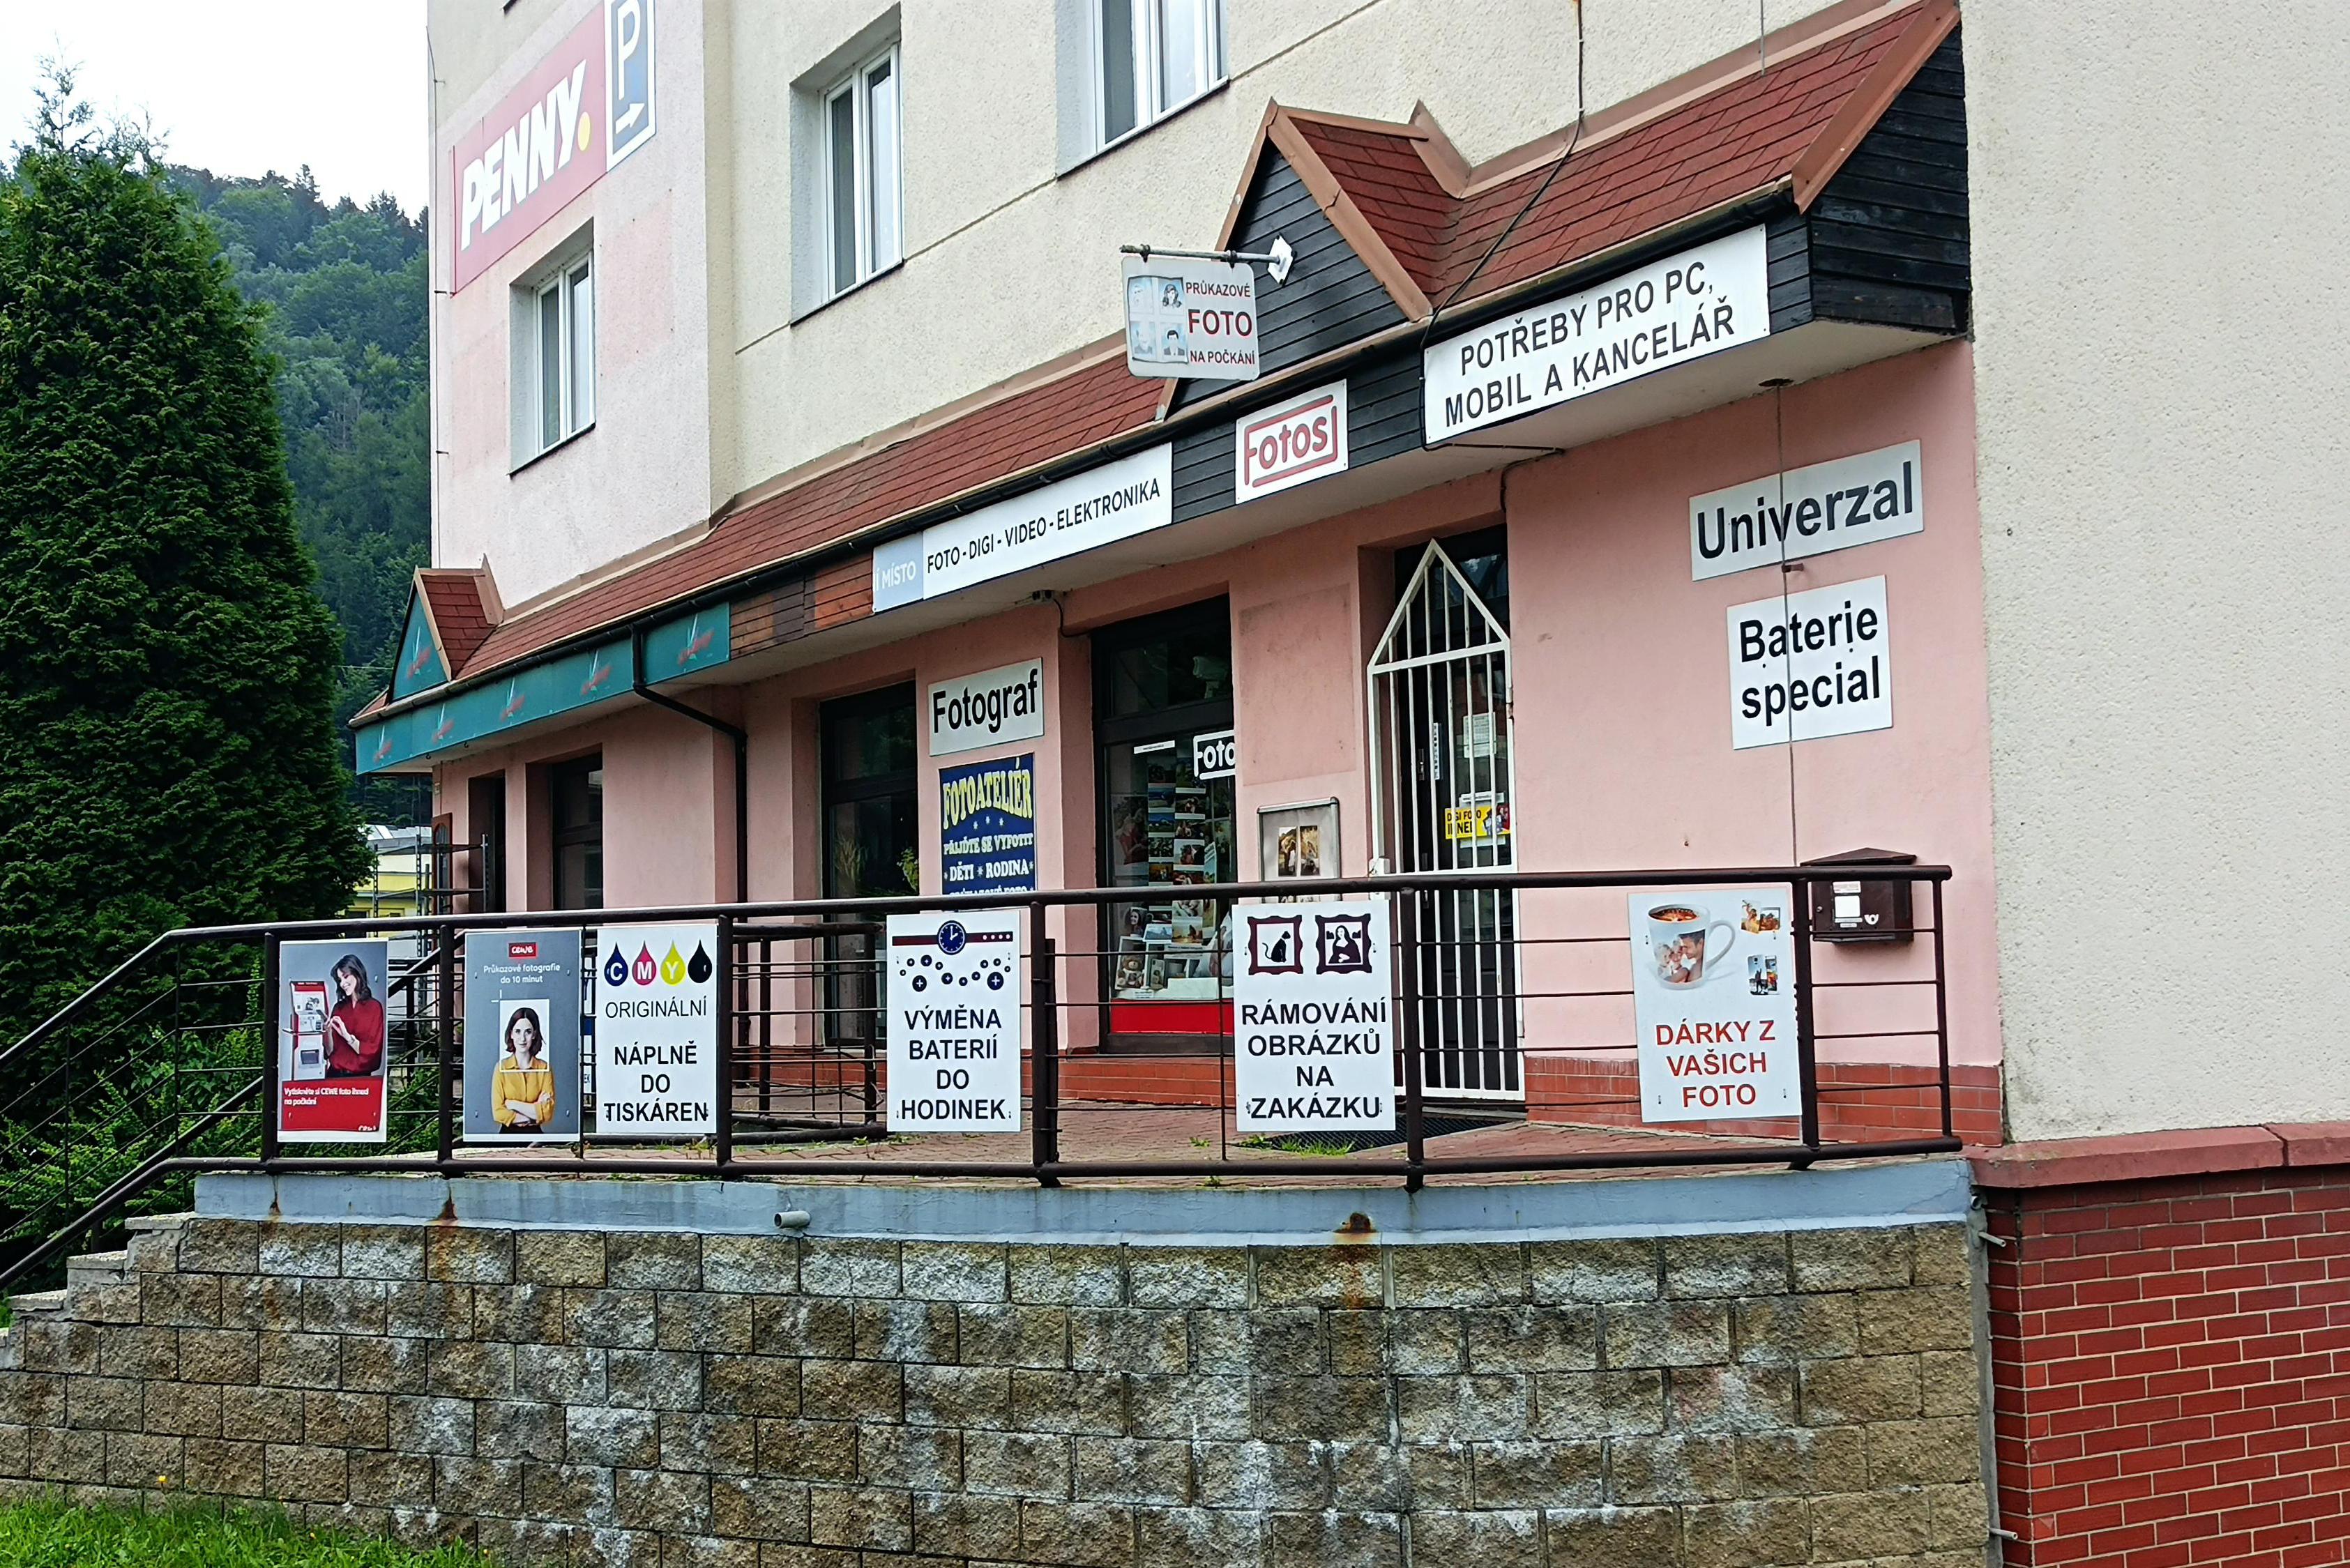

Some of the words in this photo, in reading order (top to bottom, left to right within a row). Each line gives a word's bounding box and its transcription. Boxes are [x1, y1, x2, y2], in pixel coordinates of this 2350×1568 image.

[618, 0, 641, 100] P
[1185, 280, 1251, 298] PRŮKAZOVÉ
[1188, 309, 1253, 337] FOTO
[1461, 303, 1586, 376] POTŘEBY
[1596, 281, 1654, 329] PRO
[1665, 261, 1713, 304] PC,
[1189, 351, 1206, 363] NA
[1207, 349, 1256, 365] POČKÁNÍ
[1445, 372, 1532, 427] MOBIL
[1543, 363, 1563, 396] A
[1573, 295, 1735, 387] KANCELÁŘ
[1697, 460, 1913, 560] Univerzal
[927, 546, 960, 574] FOTO
[969, 533, 994, 561] DIGI
[1004, 515, 1047, 547] VIDEO
[1056, 477, 1160, 531] ELEKTRONIKA
[881, 560, 916, 589] MÍSTO
[1740, 600, 1878, 662] Baterie
[932, 668, 1038, 733] Fotograf
[1741, 655, 1880, 726] special
[942, 756, 1033, 830] FOTOATELIÉR
[980, 835, 993, 853] SE
[993, 832, 1033, 851] VYFOTIT
[949, 860, 975, 882] DĚTI
[985, 858, 1030, 878] RODINA
[483, 964, 522, 973] Průkazové
[522, 962, 561, 973] fotografie
[500, 975, 510, 984] do
[522, 975, 543, 983] minut
[609, 961, 623, 982] C
[637, 961, 653, 980] M
[665, 960, 679, 980] Y
[605, 995, 707, 1019] ORIGINÁLNÍ
[904, 1004, 1002, 1030] VÝMĚNA
[1241, 996, 1386, 1026] RÁMOVÁNÍ
[1247, 1028, 1381, 1057] OBRÁZKŮ
[1655, 1017, 1751, 1046] DÁRKY
[1759, 1019, 1776, 1041] Z
[614, 1040, 698, 1066] NÁPLNĚ
[909, 1033, 998, 1060] BATERIÍ
[1666, 1048, 1767, 1077] VAŠICH
[641, 1074, 671, 1094] DO
[937, 1068, 970, 1090] DO
[1296, 1065, 1335, 1088] NA
[901, 1098, 1006, 1120] HODINEK
[1250, 1092, 1380, 1120] ZAKÁZKU
[1682, 1083, 1757, 1108] FOTO
[604, 1097, 708, 1122] TISKÁREN
